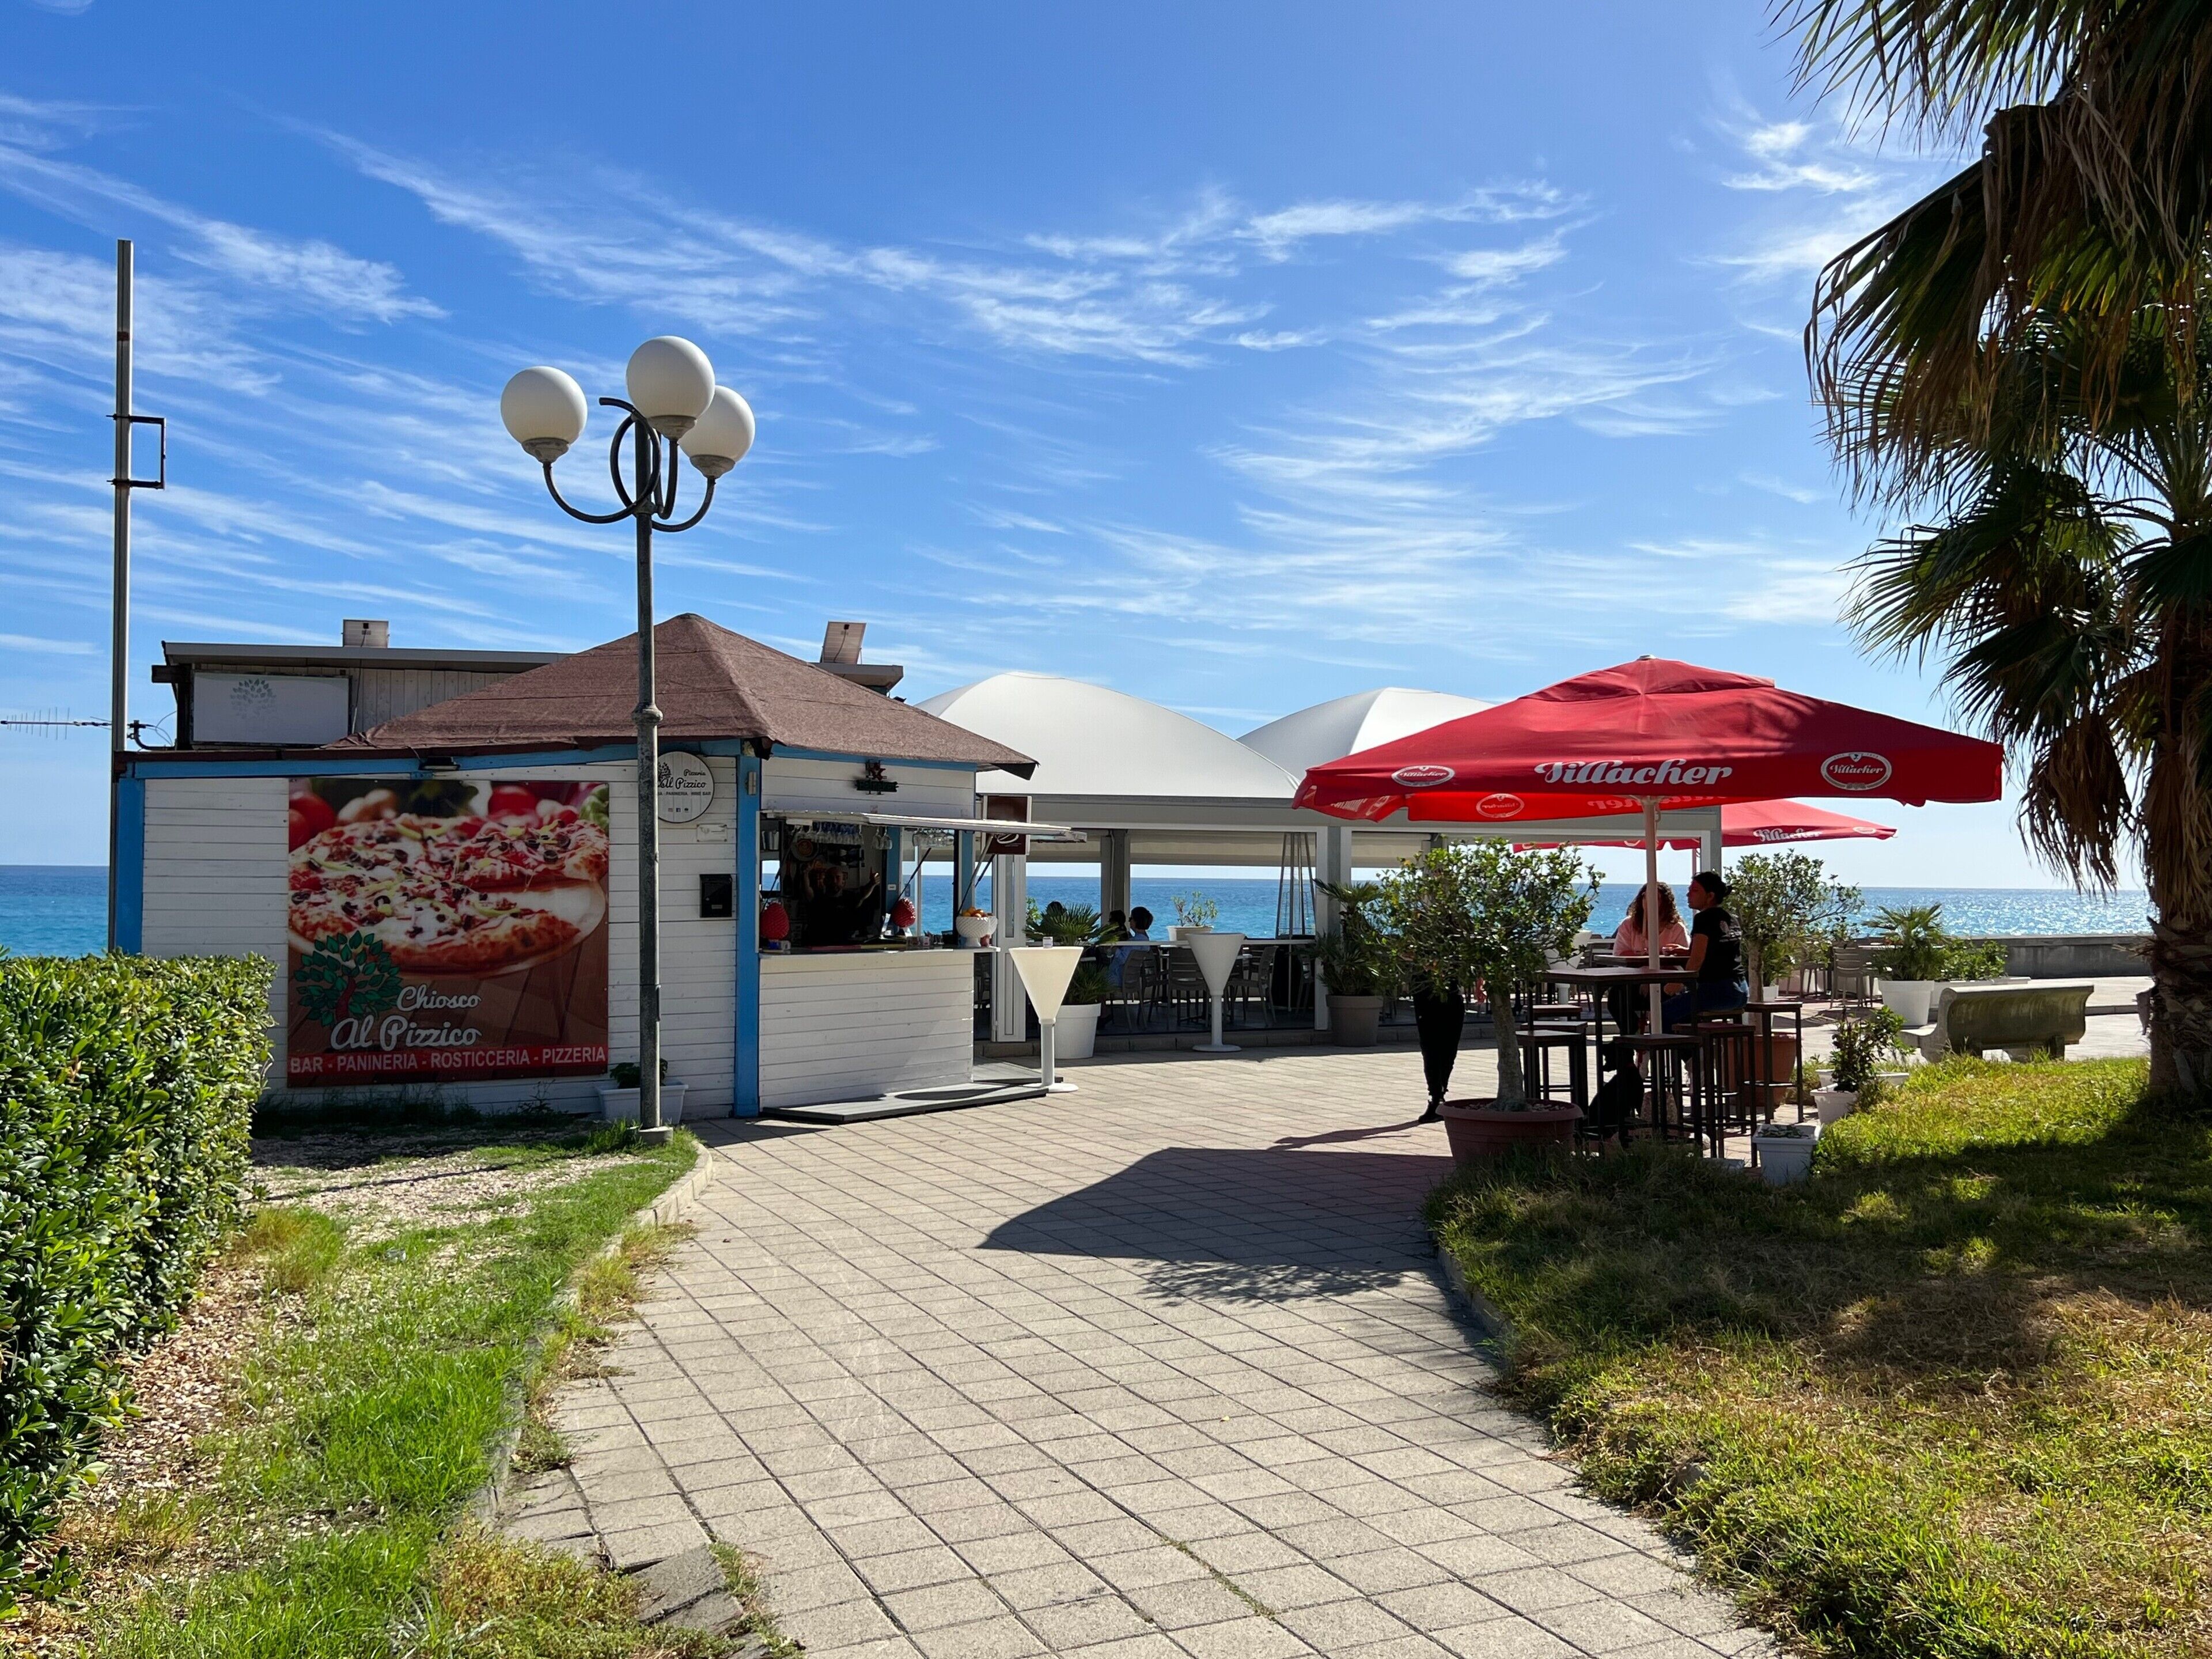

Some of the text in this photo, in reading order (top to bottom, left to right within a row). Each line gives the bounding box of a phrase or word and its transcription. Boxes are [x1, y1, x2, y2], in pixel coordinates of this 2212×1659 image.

[1534, 758, 1733, 785] Villacher
[1830, 764, 1883, 774] Villacher
[658, 777, 707, 789] Al Pizzico
[396, 984, 482, 1012] Chiosco
[330, 1014, 482, 1052] Al Pizzico
[290, 1056, 324, 1073] BAR
[337, 1053, 418, 1072] PANINERIA
[431, 1049, 531, 1069] ROSTICCERIA
[543, 1047, 606, 1065] PIZZERIA
